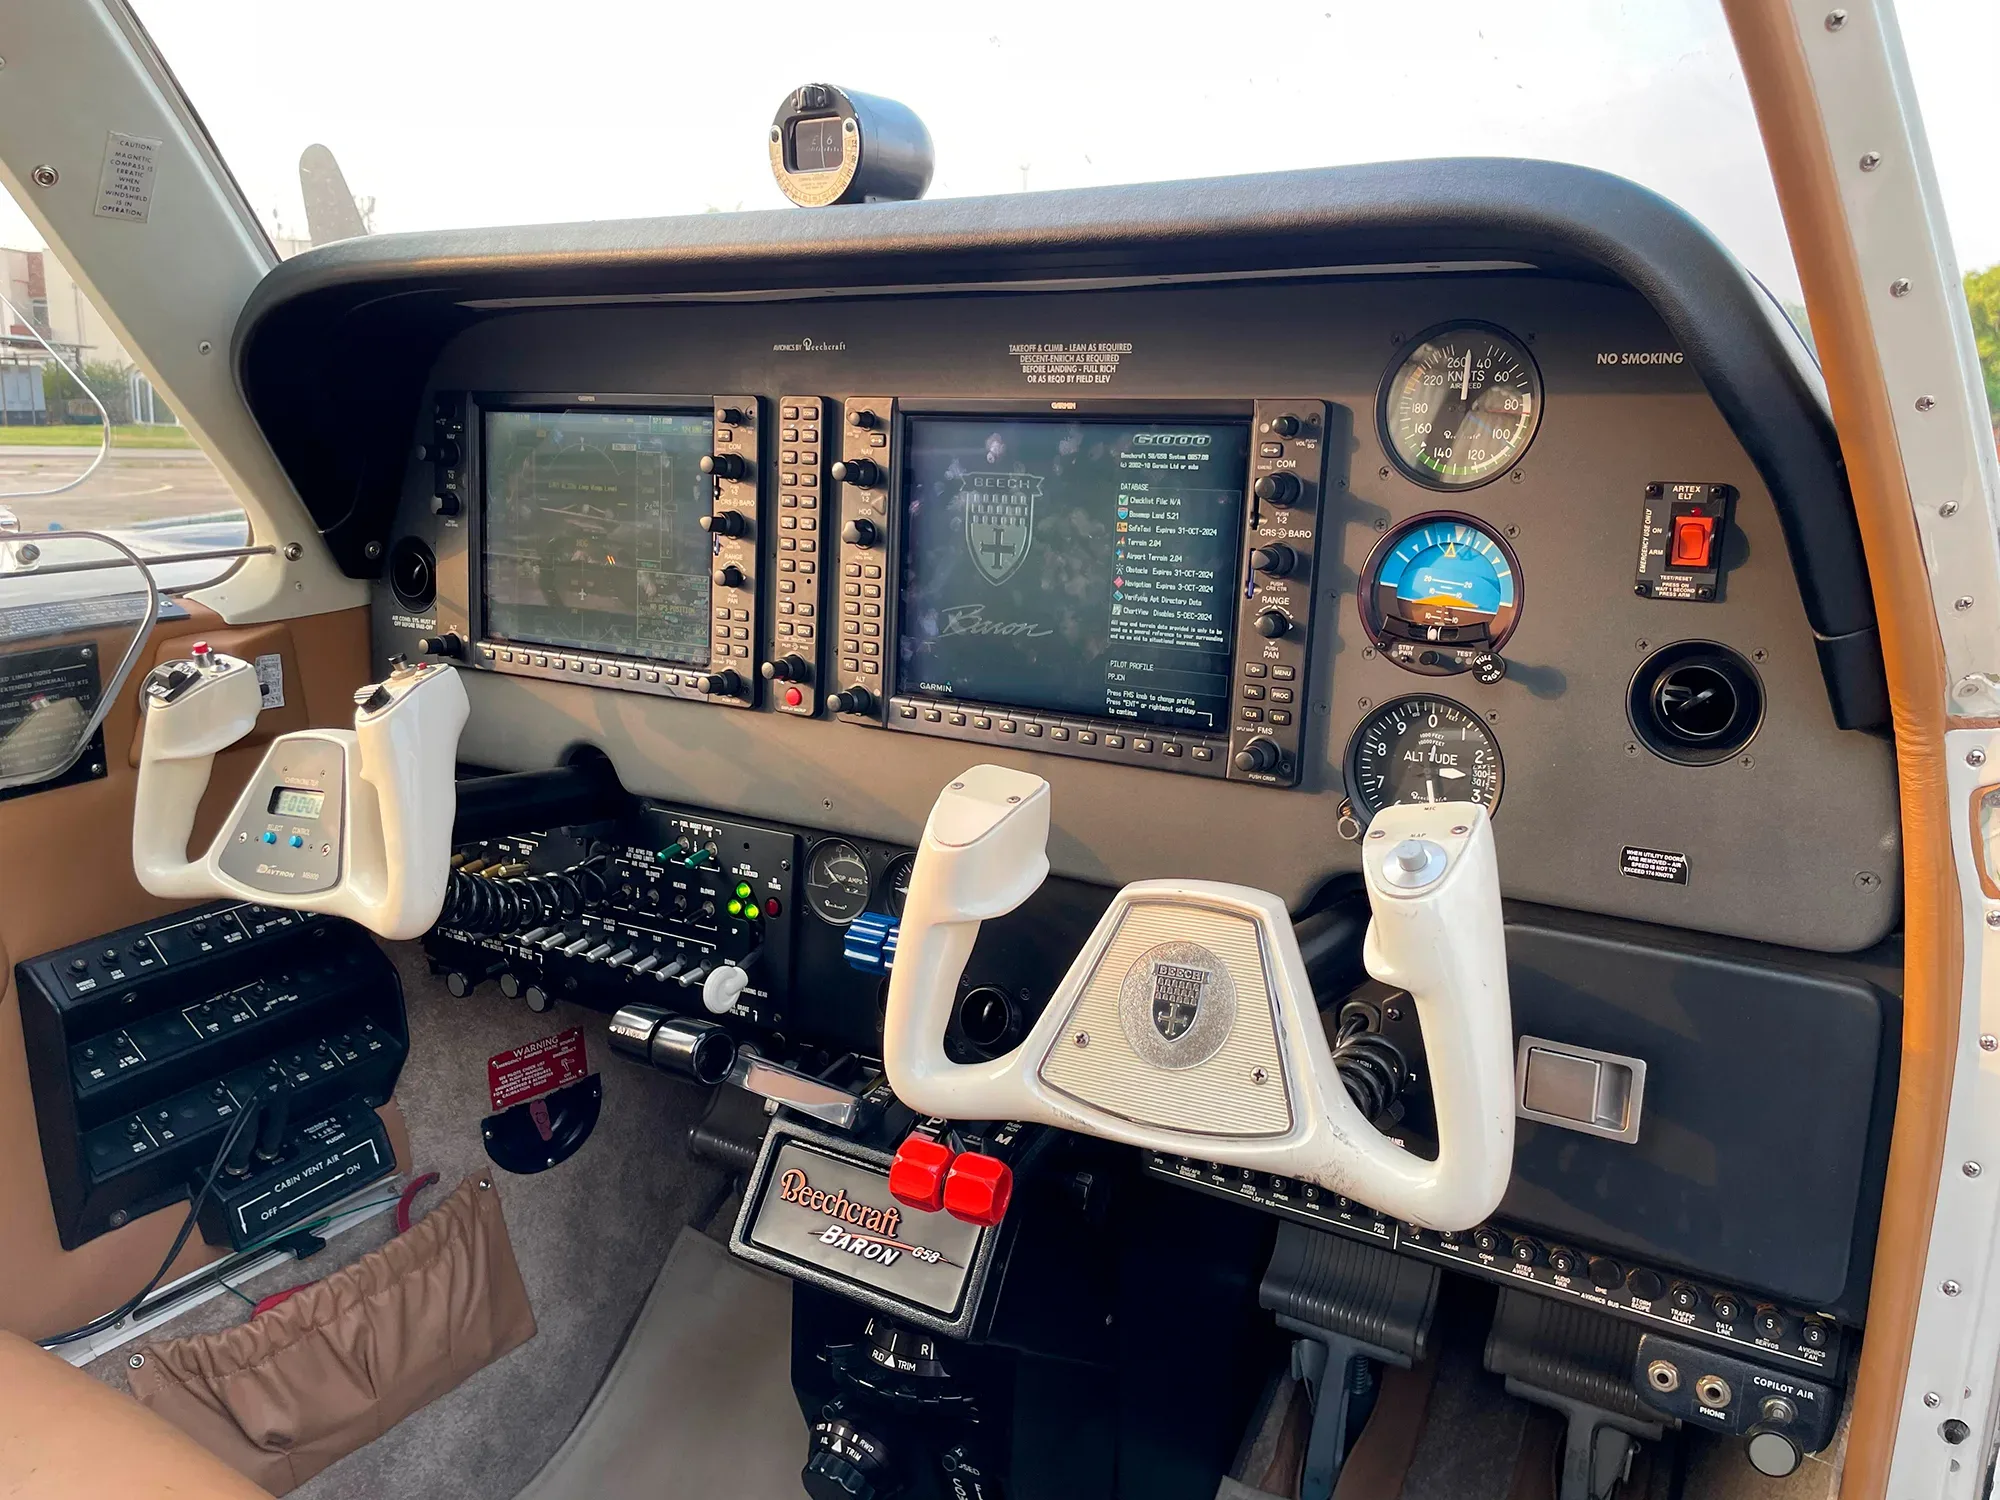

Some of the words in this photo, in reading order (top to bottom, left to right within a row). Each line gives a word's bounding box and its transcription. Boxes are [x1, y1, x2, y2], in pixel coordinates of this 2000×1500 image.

[120, 141, 152, 151] CAUTION
[115, 152, 152, 163] MAGNETIC
[110, 159, 144, 170] COMPASS
[106, 190, 147, 202] WINDSHIELD
[102, 205, 142, 216] OPERATION
[803, 338, 846, 351] Beechcraft
[1099, 343, 1132, 351] REQUIRED
[1447, 357, 1466, 368] 260
[1477, 358, 1492, 369] 40
[1597, 353, 1618, 365] NO
[1621, 352, 1684, 365] SMOKING
[1424, 375, 1443, 386] 220
[1494, 371, 1509, 382] 60
[1448, 370, 1485, 382] KNTS
[1412, 403, 1428, 413] 180
[1504, 399, 1519, 410] 80
[1415, 423, 1432, 434] 160
[1493, 429, 1510, 440] 100
[1434, 448, 1452, 458] 140
[1468, 450, 1485, 460] 120
[974, 477, 1030, 489] BEECH
[1121, 483, 1149, 491] DATABASE
[1130, 496, 1153, 505] Checklist
[1156, 526, 1176, 534] Expires
[1177, 527, 1217, 536] 31-OCT-2024
[1260, 528, 1276, 537] CRS
[1288, 529, 1312, 538] BARO
[1639, 536, 1649, 573] EMERGENCY
[1125, 580, 1151, 589] Navigation
[1156, 582, 1176, 591] Expires
[1178, 583, 1213, 593] 3-OCT-2024
[1262, 596, 1289, 606] RANGE
[1263, 651, 1279, 659] PAN
[1129, 662, 1154, 671] PROFILE
[12, 669, 52, 681] LIMITATIONS
[1274, 669, 1291, 677] MENU
[1482, 670, 1500, 682] CAGE
[0, 683, 32, 693] EXTENDED
[34, 676, 67, 688] (NORMAL)
[920, 681, 952, 693] GARMIN
[1272, 692, 1289, 700] PROC
[1258, 727, 1273, 735] FMS
[1397, 721, 1407, 735] 9
[1429, 715, 1438, 728] 0
[1378, 743, 1386, 756] 8
[1475, 750, 1484, 763] 2
[1377, 776, 1385, 788] 7
[1471, 789, 1480, 802] 3
[292, 827, 310, 836] CONTROL
[1640, 857, 1667, 866] REMOVED
[1159, 965, 1202, 982] BEECH
[513, 1036, 558, 1057] WARNING
[994, 1133, 1013, 1145] M
[274, 1176, 300, 1193] CABIN
[302, 1162, 323, 1178] VENT
[326, 1154, 340, 1166] AIR
[261, 1207, 278, 1221] OFF
[346, 1163, 361, 1175] ON
[780, 1168, 901, 1238] Beechcraft
[819, 1224, 901, 1266] BARON
[911, 1246, 940, 1264] G58
[1580, 1292, 1606, 1305] AVIONICS
[1607, 1300, 1619, 1309] BUS
[1632, 1296, 1652, 1307] STORM
[1680, 1294, 1687, 1304] 5
[1723, 1306, 1729, 1315] 3
[1631, 1302, 1650, 1312] SCOPE
[1671, 1308, 1696, 1321] TRAFFIC
[1672, 1314, 1693, 1325] ALERT
[1716, 1322, 1733, 1332] DATA
[1717, 1327, 1731, 1337] LINK
[921, 1344, 929, 1355] R
[1755, 1338, 1779, 1350] SERVOS
[1798, 1345, 1826, 1358] AVIONICS
[1804, 1352, 1818, 1361] FAN
[872, 1349, 884, 1362] RUD
[898, 1360, 916, 1372] TRIM
[1754, 1376, 1793, 1394] COPILOT
[1796, 1389, 1814, 1400] AIR
[1700, 1406, 1726, 1420] PHONE
[860, 1438, 874, 1452] RWD
[846, 1447, 862, 1461] TRIM
